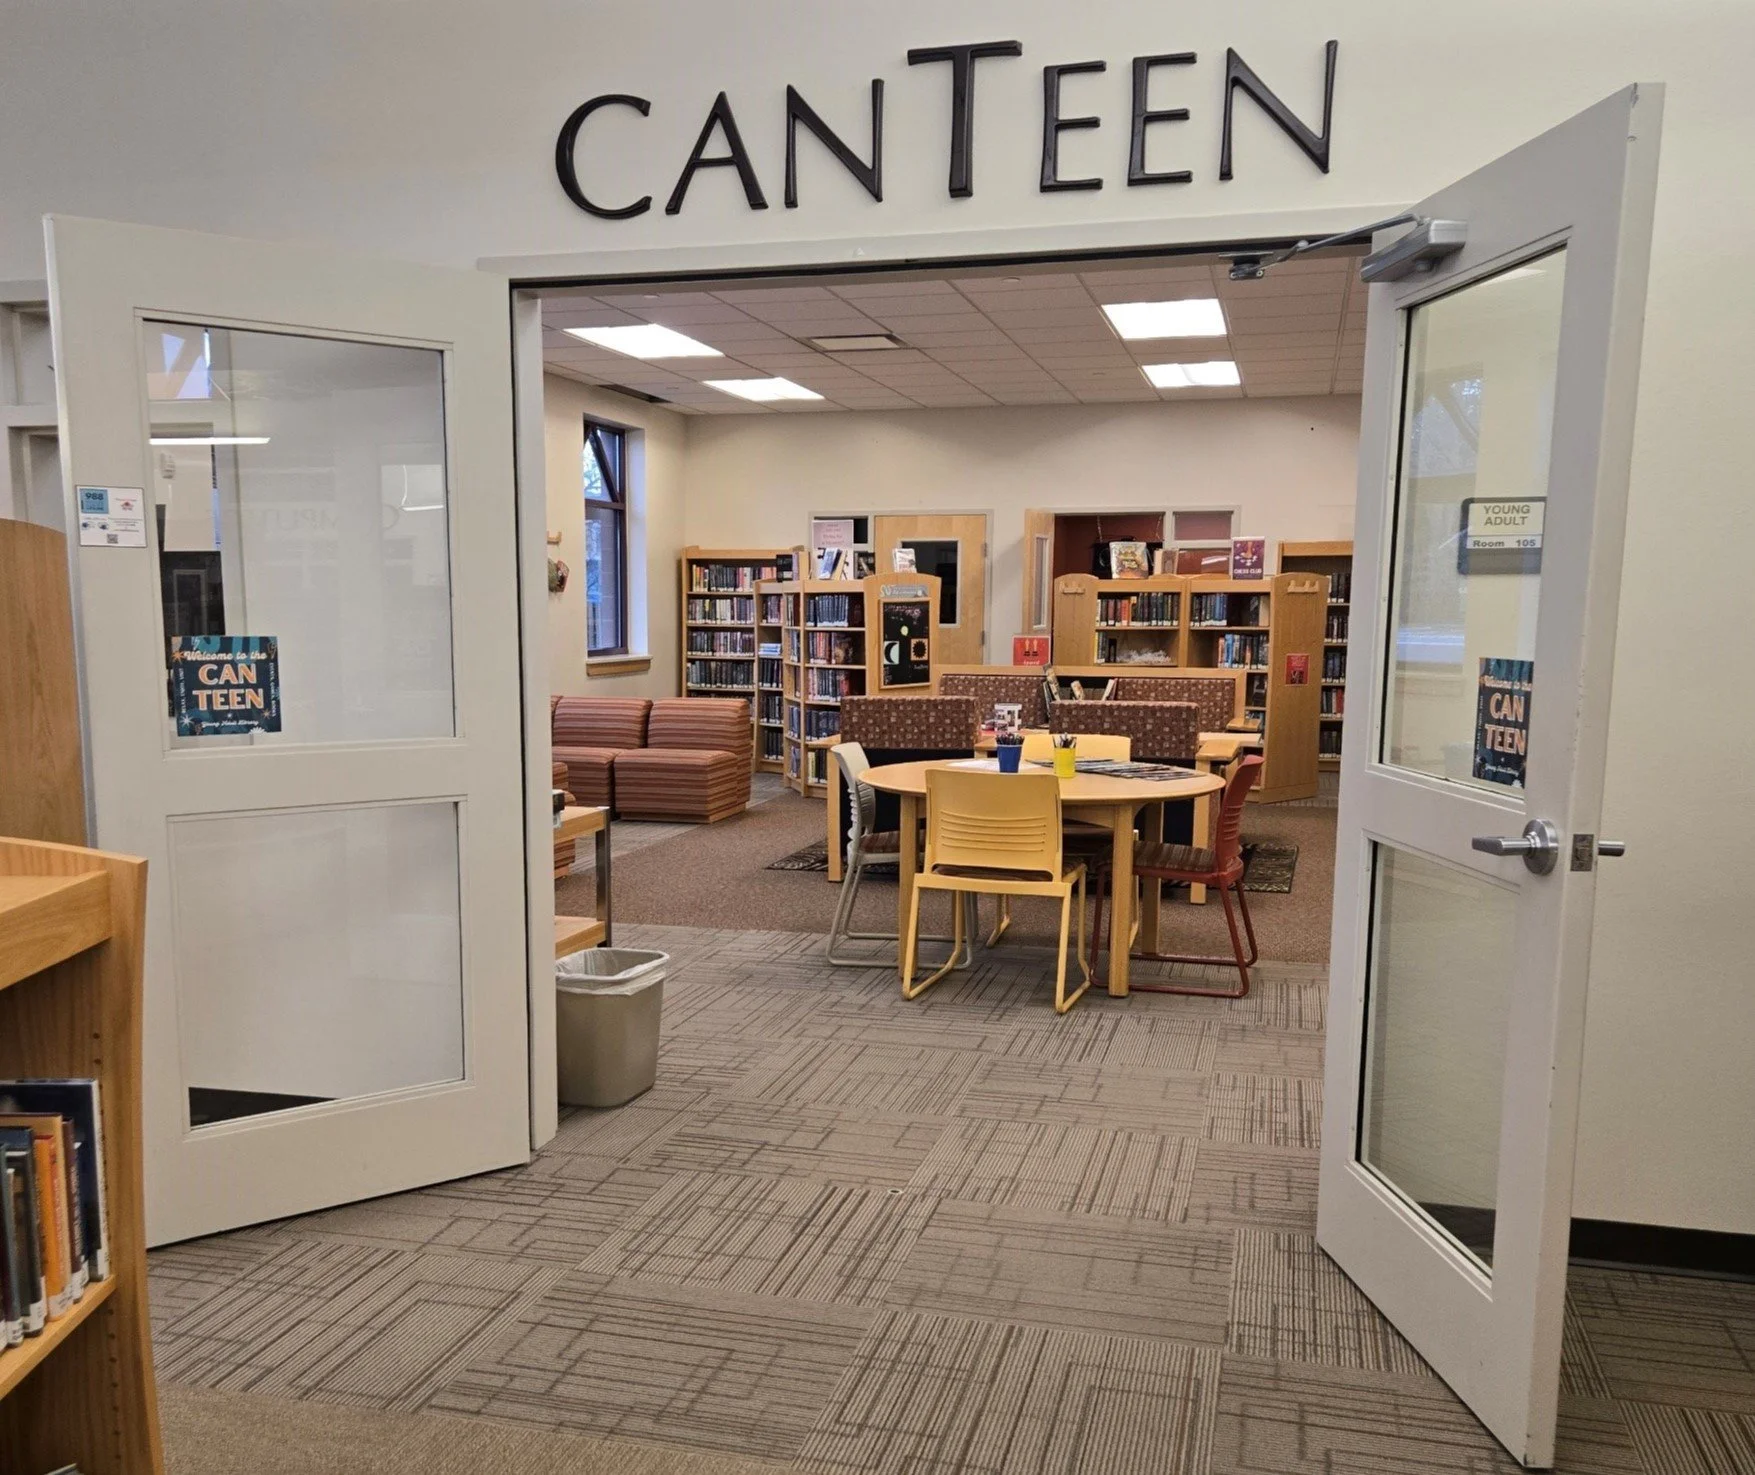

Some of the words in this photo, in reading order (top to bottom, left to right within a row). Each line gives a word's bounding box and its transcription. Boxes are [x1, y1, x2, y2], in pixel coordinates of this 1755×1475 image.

[555, 39, 1339, 220] CANTEEN
[85, 492, 104, 500] 988
[1483, 504, 1531, 515] YOUNG
[1483, 516, 1528, 526] ADULT
[1473, 540, 1505, 548] Room
[1516, 539, 1537, 547] 105
[183, 650, 234, 661] Welcome
[236, 651, 248, 660] to
[250, 650, 267, 660] the
[198, 663, 257, 686] CAN
[192, 688, 264, 711] TEEN
[1489, 692, 1525, 723] CAN
[1484, 723, 1526, 756] TEEN
